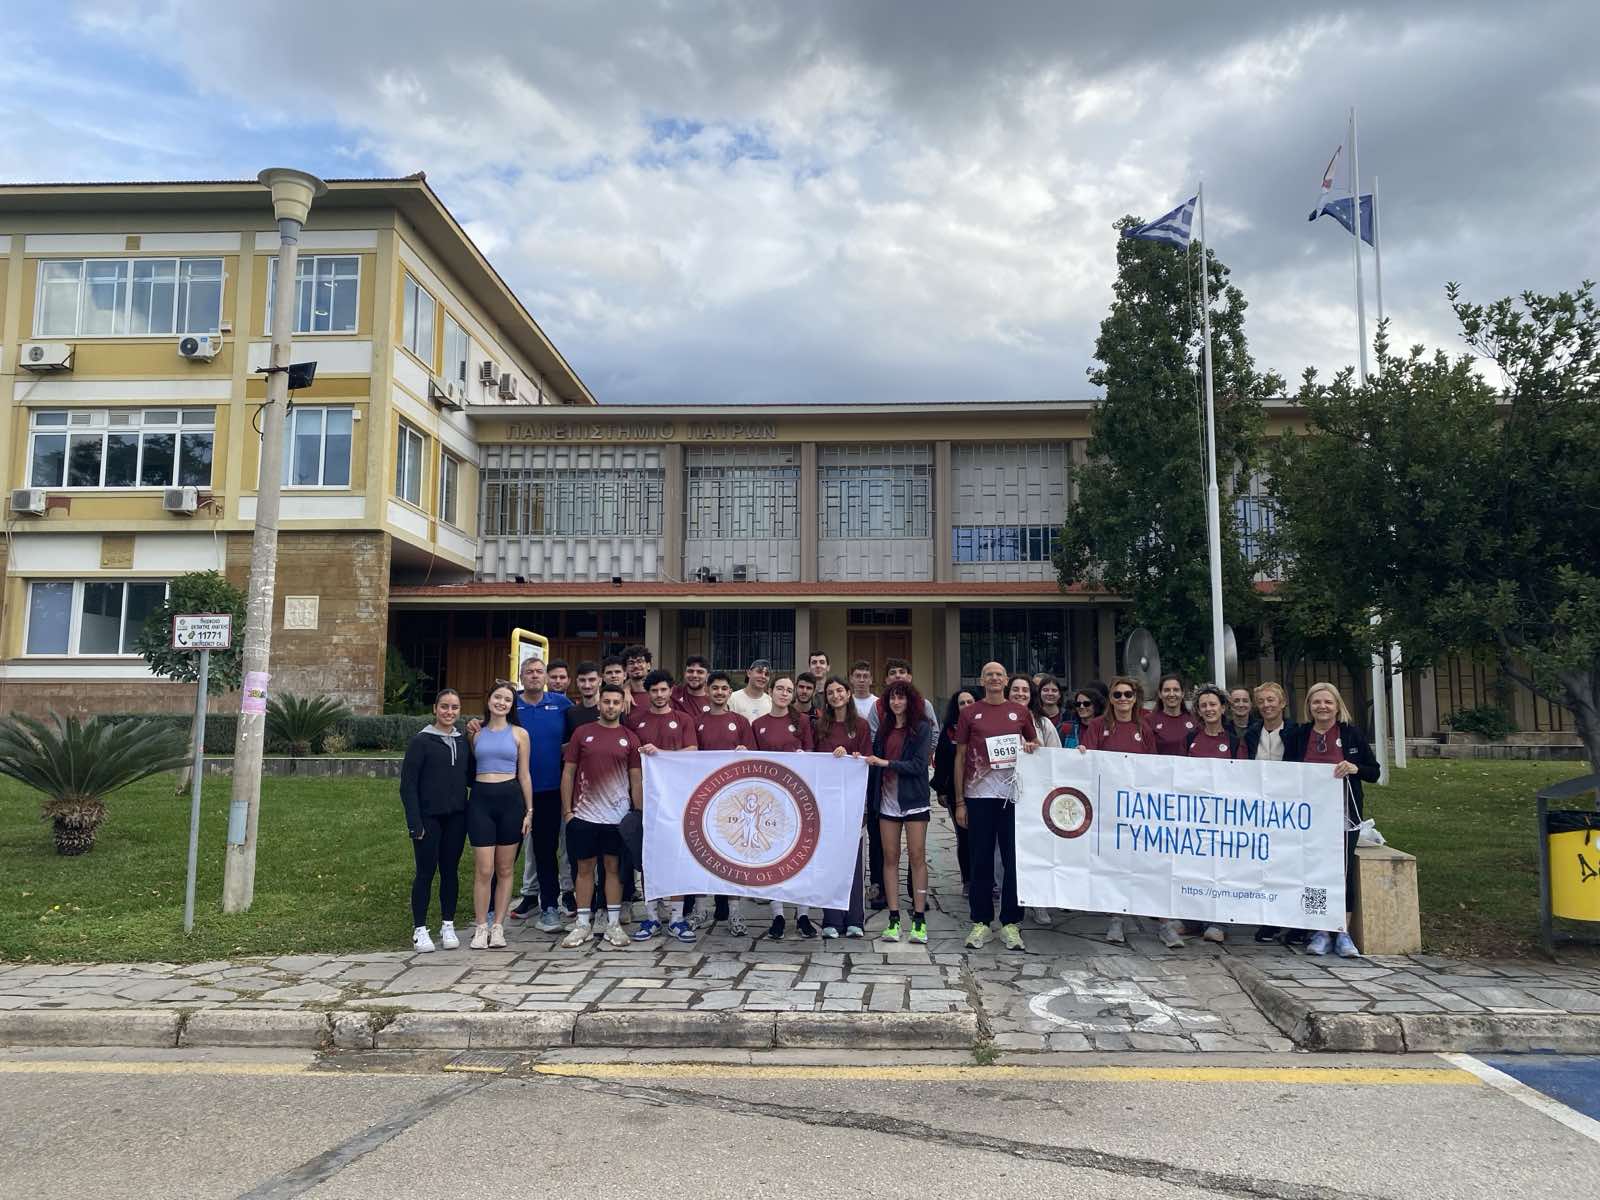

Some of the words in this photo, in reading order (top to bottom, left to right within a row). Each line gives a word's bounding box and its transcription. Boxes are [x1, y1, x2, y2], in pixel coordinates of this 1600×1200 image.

[505, 423, 676, 440] ΠΑΝΕΠΙΣΤΗΜΙΟ
[687, 422, 777, 440] ΠΑΤΡΩΝ
[198, 631, 222, 640] 11771
[994, 746, 1016, 756] 9619
[689, 763, 778, 816] ΠΑΝΕΠΙΣΤΗΜΙΟ
[782, 773, 816, 821] ΠΑΤΡΩΝ
[1116, 790, 1311, 831] ΠΑΝΕΠΙΣΤΗΜΙΑΚΟ
[727, 816, 738, 824] 19
[765, 819, 777, 827] 64
[1116, 823, 1270, 861] ΓΥΜΝΑΣΤΗΡΙΟ
[688, 829, 752, 881] UNIVERSITY
[756, 872, 775, 881] OF
[779, 838, 813, 876] PATRAS
[1181, 885, 1278, 903] https://gym.upatras.gr
